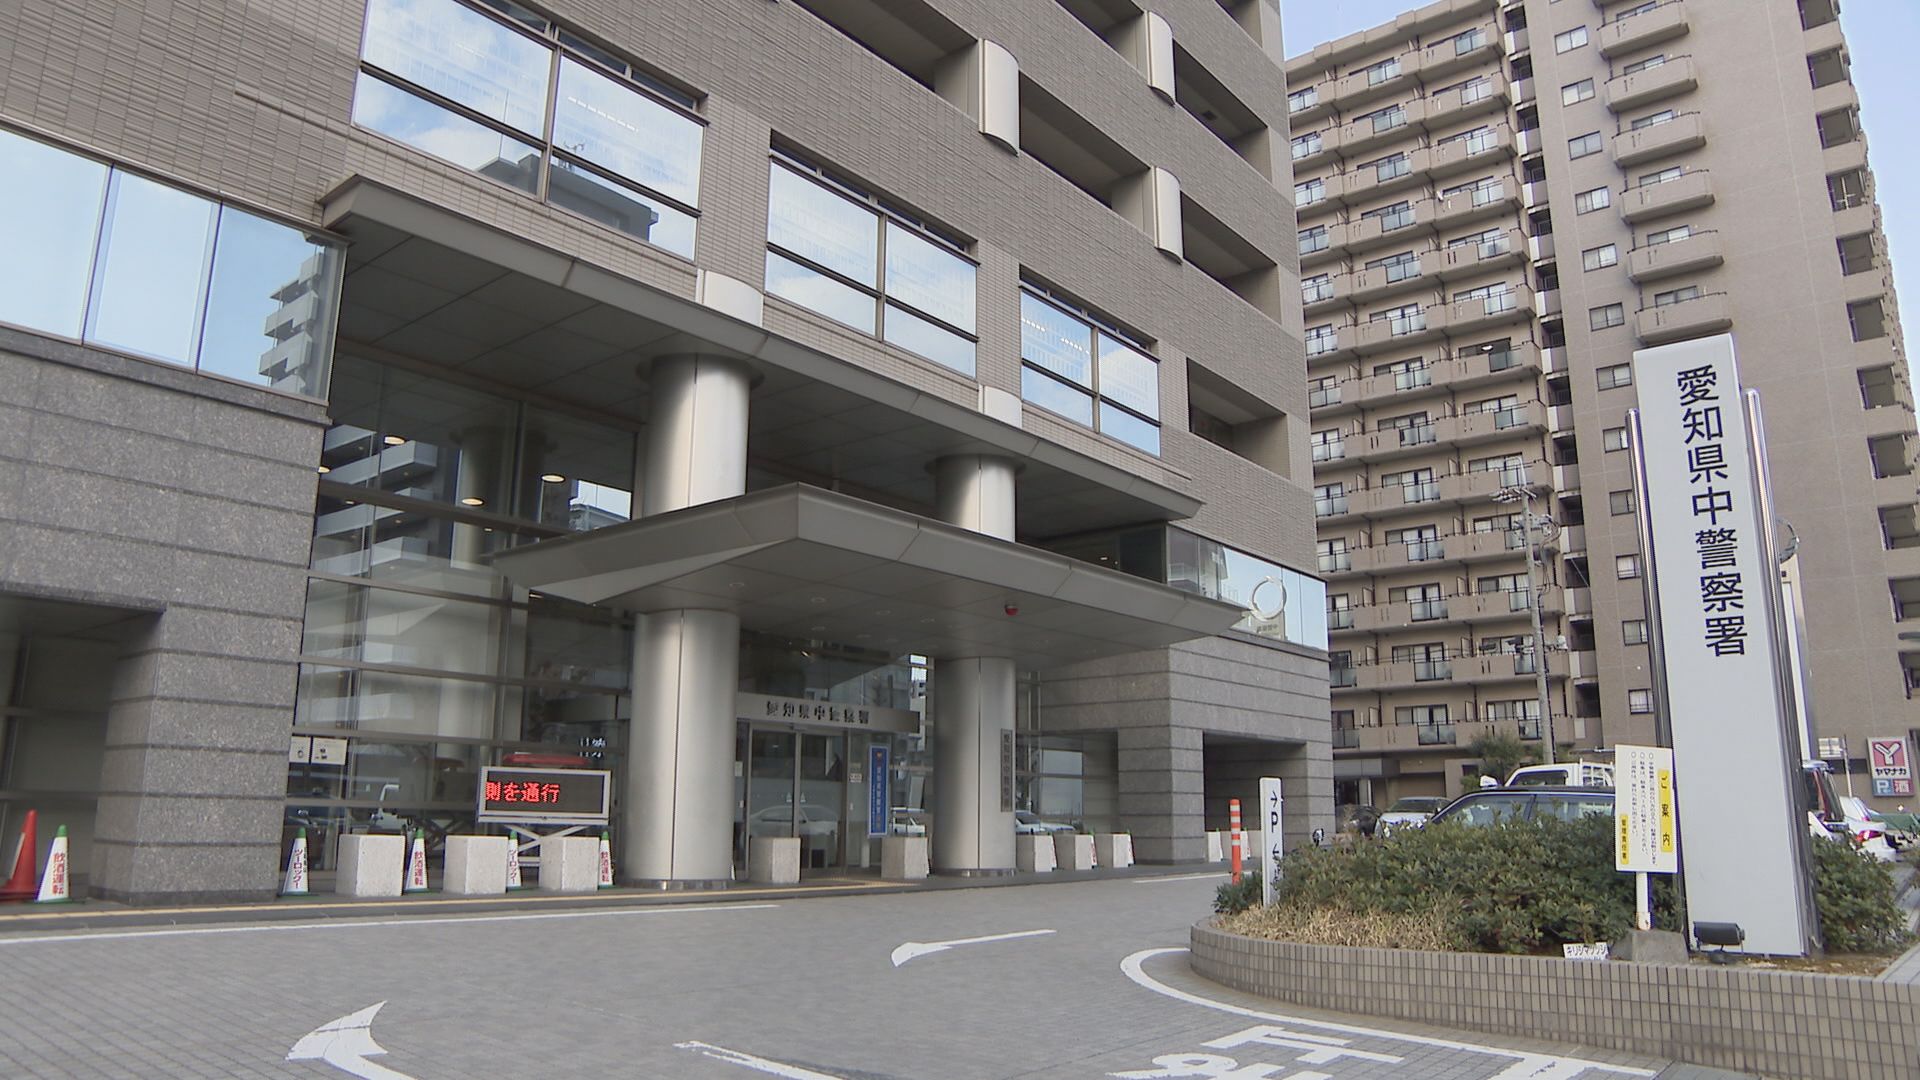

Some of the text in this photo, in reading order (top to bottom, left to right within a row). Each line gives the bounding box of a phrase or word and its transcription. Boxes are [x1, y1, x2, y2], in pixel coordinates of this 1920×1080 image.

[1676, 363, 1748, 658] 愛知県中警察署
[1875, 768, 1907, 776] ヤマナカ
[1894, 780, 1910, 793] 酒
[1271, 811, 1279, 833] P
[1661, 775, 1671, 847] ご案内
[52, 852, 65, 895] 飲酒運転
[414, 851, 423, 886] 飲酒運転
[601, 851, 609, 882] 飲酒運転
